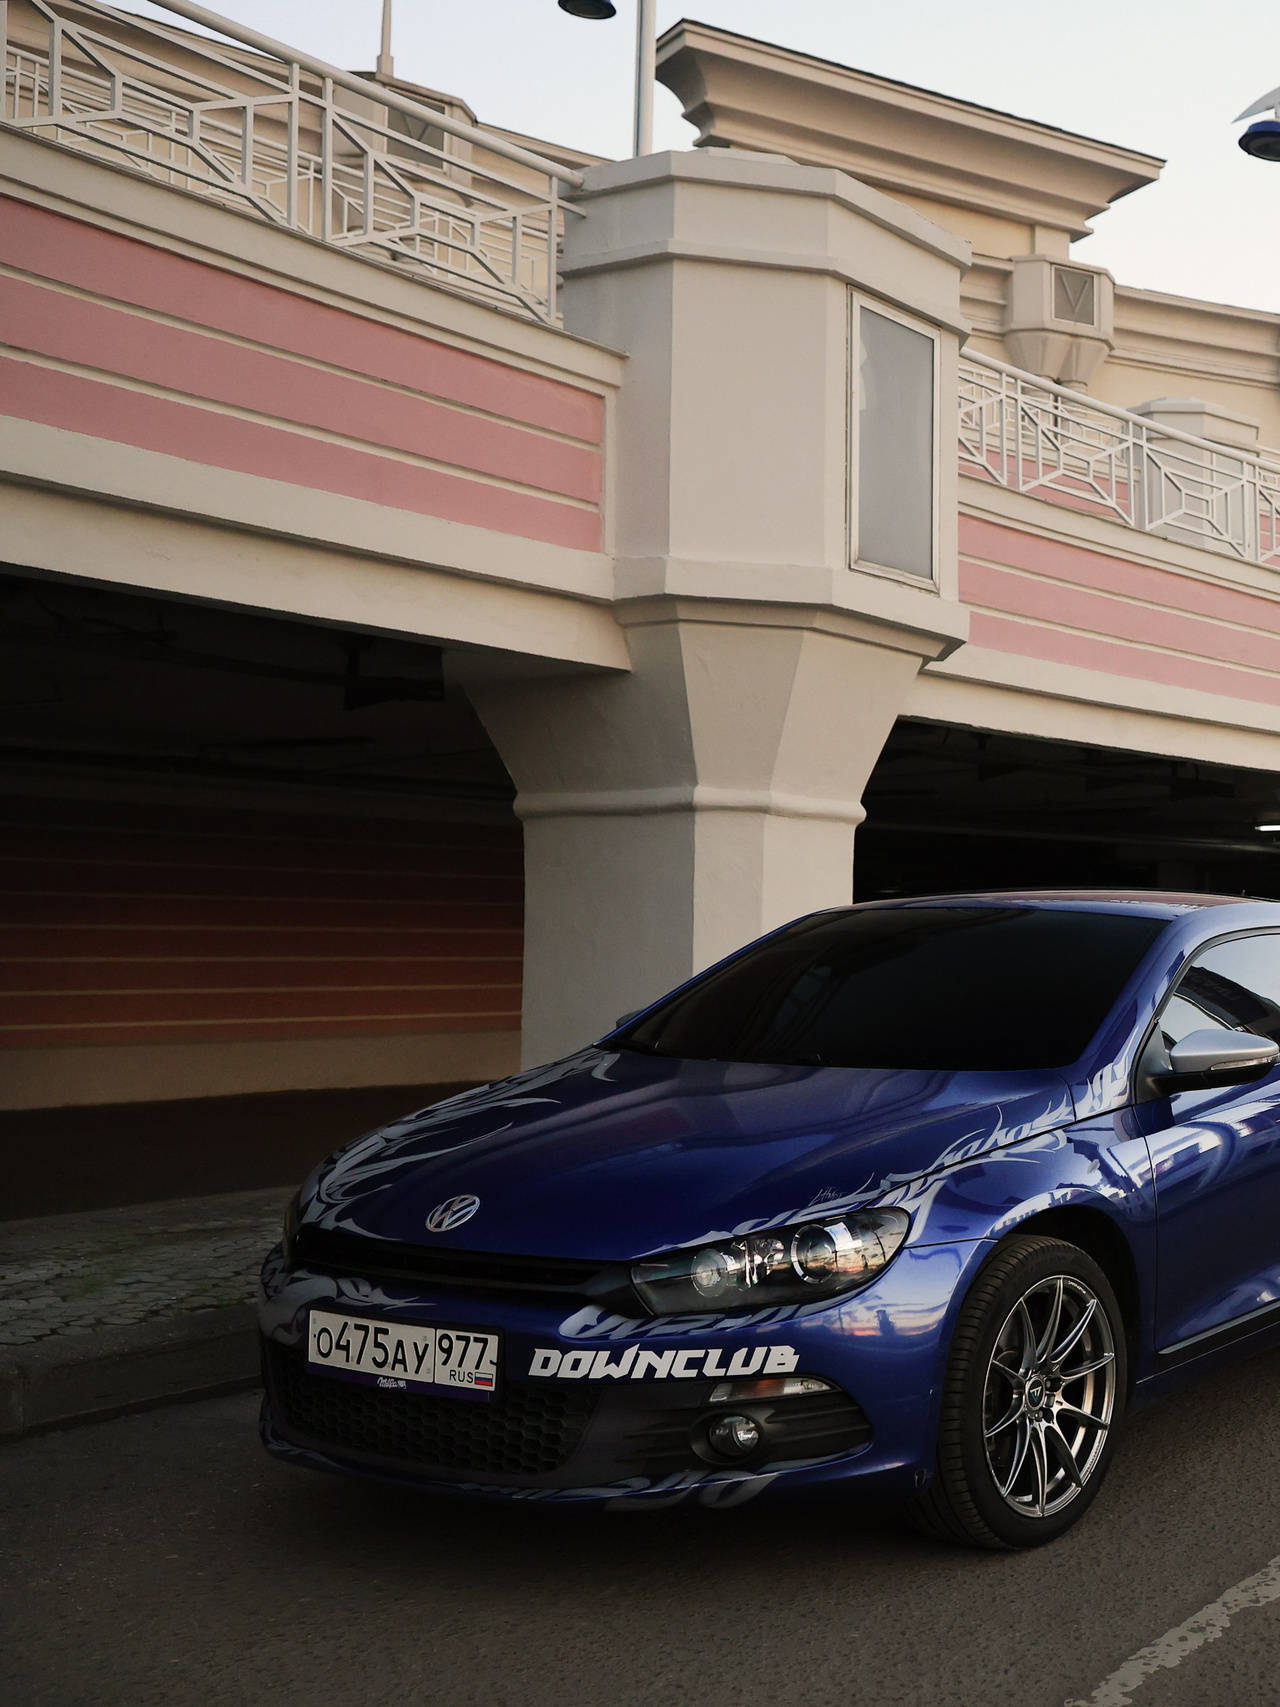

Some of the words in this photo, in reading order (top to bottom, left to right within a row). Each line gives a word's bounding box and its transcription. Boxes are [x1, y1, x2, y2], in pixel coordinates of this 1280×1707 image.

[438, 1333, 489, 1370] 977
[528, 1343, 800, 1379] DOWNCLUB
[449, 1369, 474, 1384] RUS
